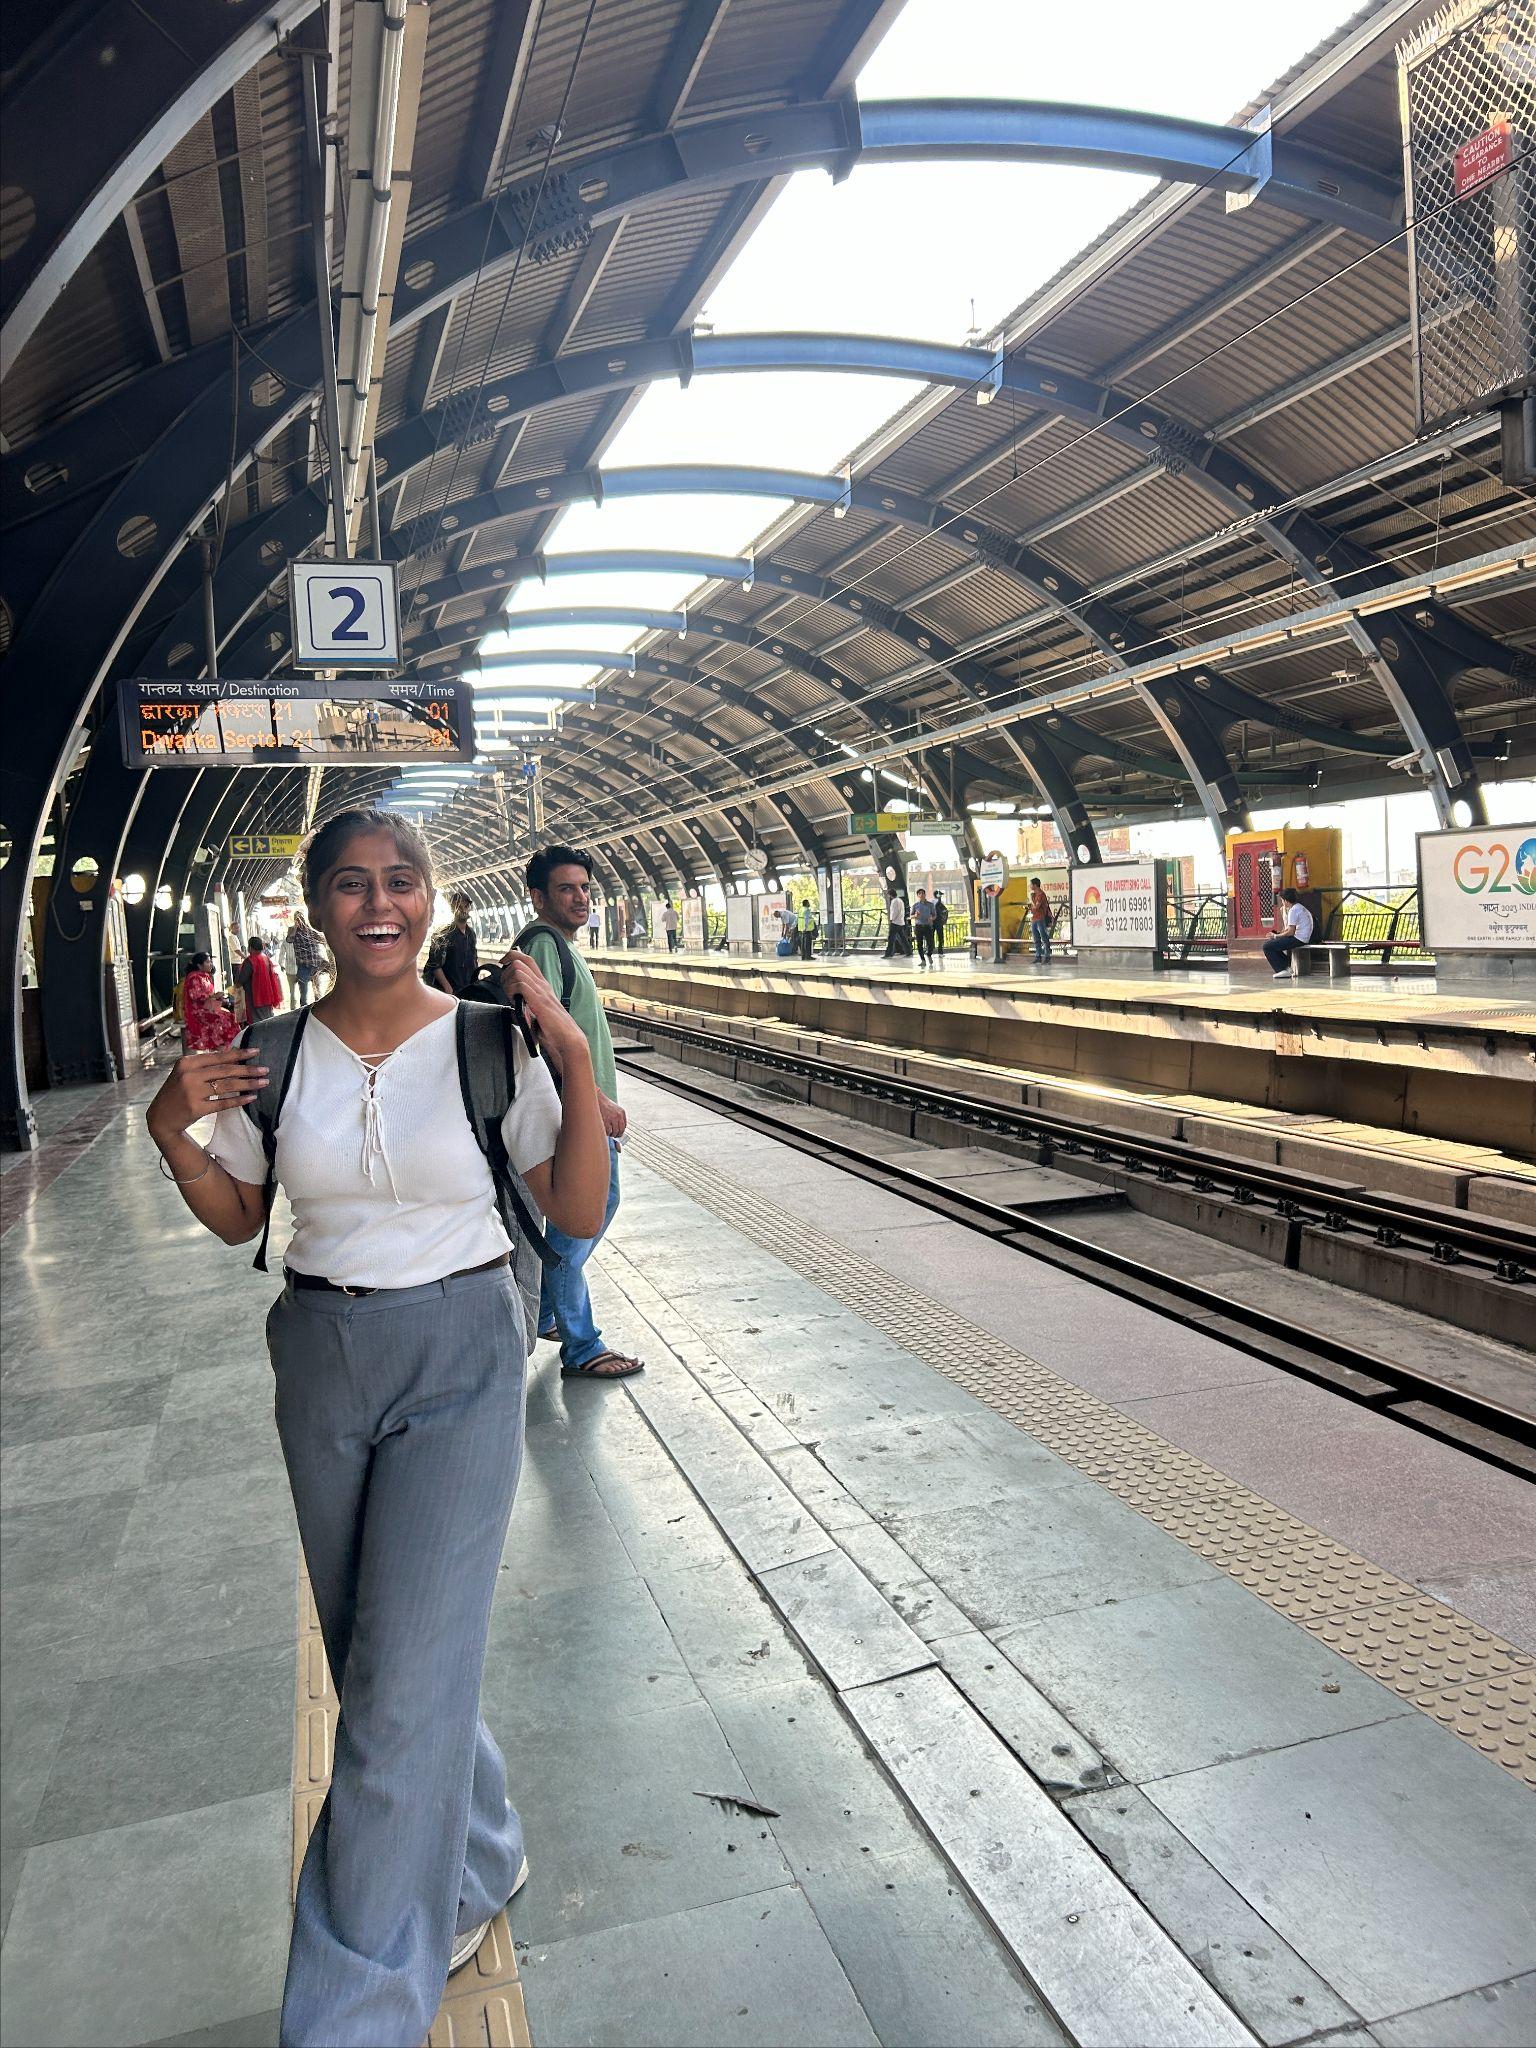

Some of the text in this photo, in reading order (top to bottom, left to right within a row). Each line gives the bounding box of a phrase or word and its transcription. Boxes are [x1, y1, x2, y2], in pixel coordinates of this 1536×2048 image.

[1463, 127, 1501, 158] CAUTION
[1463, 137, 1503, 167] CLEARANCE
[1478, 156, 1488, 167] TO
[1478, 153, 1505, 177] NEARBY
[328, 586, 369, 640] 2
[139, 683, 182, 696] गन्तव्य
[272, 702, 292, 720] 21
[141, 728, 313, 749] Dwarka Sector 21
[1104, 880, 1113, 891] FOR
[1075, 905, 1097, 919] Jagran
[1105, 897, 1151, 912] 70110 69981
[1501, 905, 1518, 913] 2023
[1519, 903, 1536, 911] INDI
[1106, 917, 1153, 931] 93122 70803
